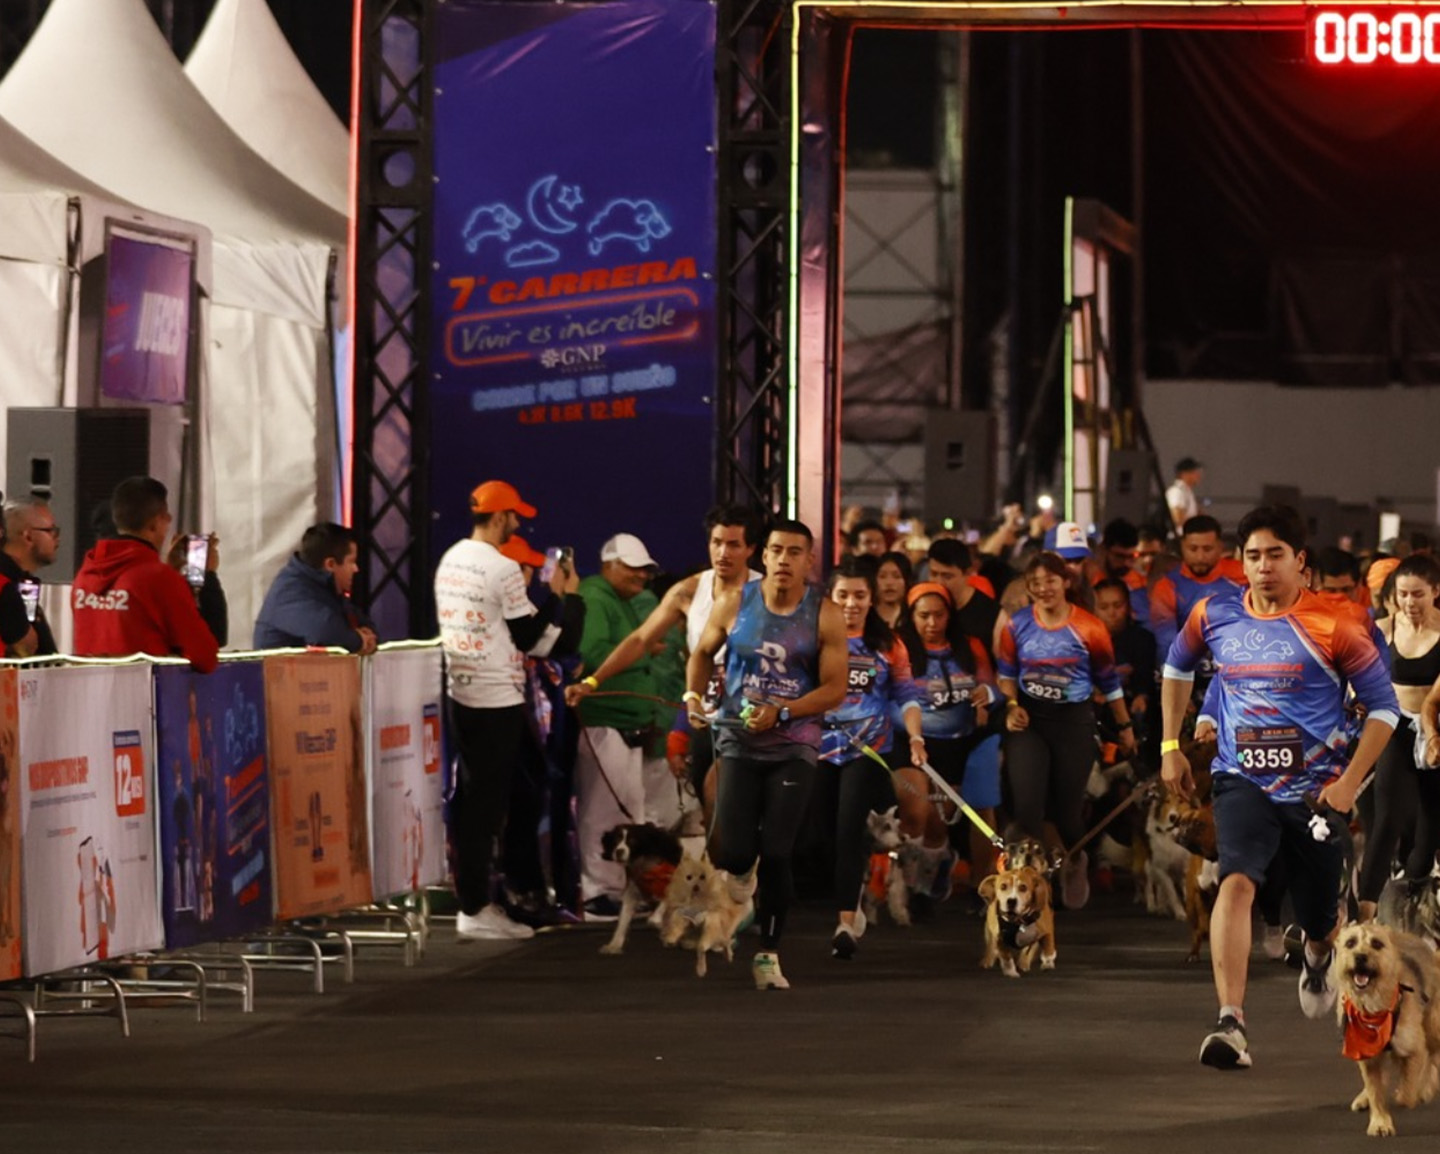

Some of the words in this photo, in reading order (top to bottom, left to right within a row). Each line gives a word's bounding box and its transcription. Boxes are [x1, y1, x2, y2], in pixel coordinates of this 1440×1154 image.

[488, 257, 698, 305] CARRERA
[461, 322, 522, 353] Vivir
[528, 324, 553, 344] es
[558, 301, 677, 340] increíble
[561, 344, 607, 367] GNP
[75, 588, 129, 610] 24:52
[1027, 681, 1062, 700] 2923
[1243, 748, 1293, 769] 3359
